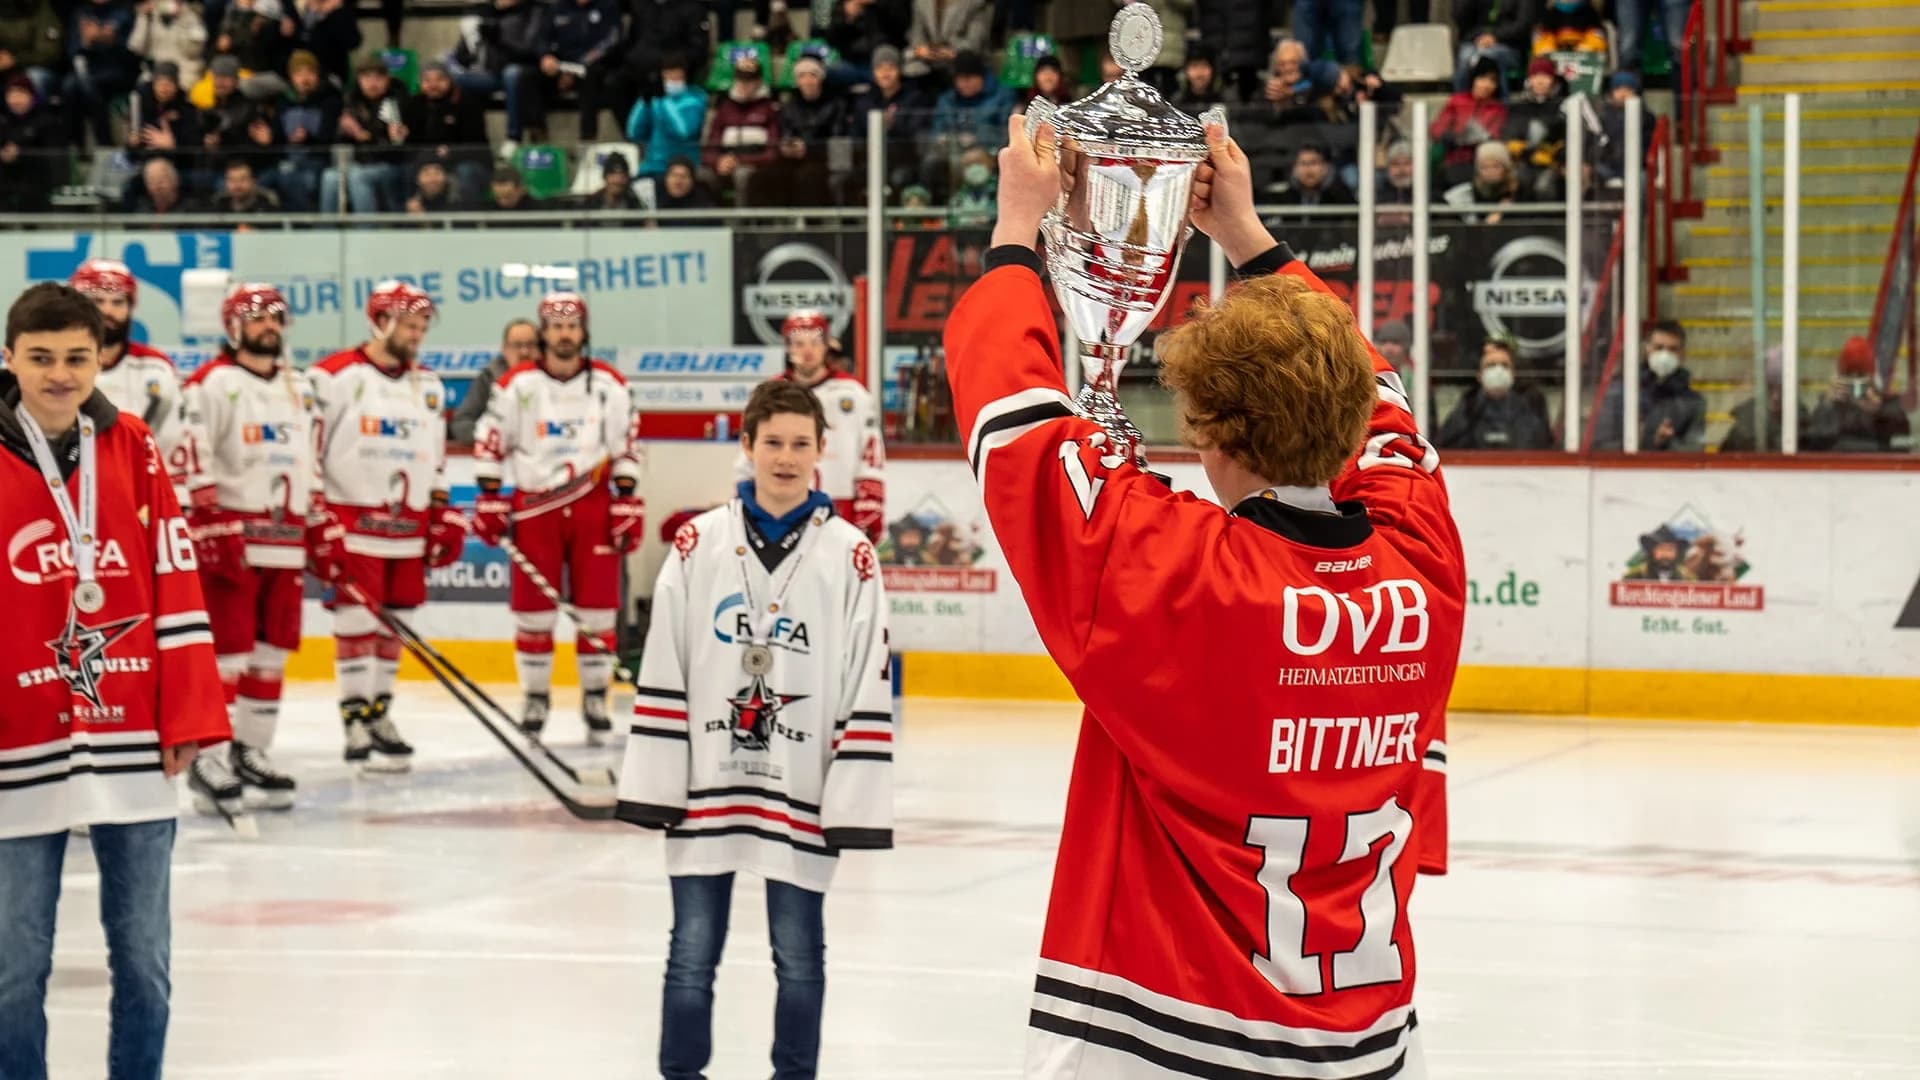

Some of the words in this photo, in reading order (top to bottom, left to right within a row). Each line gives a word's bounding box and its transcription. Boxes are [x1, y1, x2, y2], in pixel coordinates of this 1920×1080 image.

[278, 276, 341, 316] ÜR
[754, 292, 845, 307] NISSAN
[156, 516, 198, 575] 16
[1314, 555, 1372, 573] BAUER
[736, 612, 811, 647] RFA
[1283, 578, 1429, 656] OVB
[1641, 616, 1684, 633] Echt.
[1691, 618, 1729, 635] Gut.
[1279, 661, 1427, 686] HEIMATZEITUNGEN
[1268, 711, 1419, 774] BITTNER
[1244, 794, 1415, 996] 17
